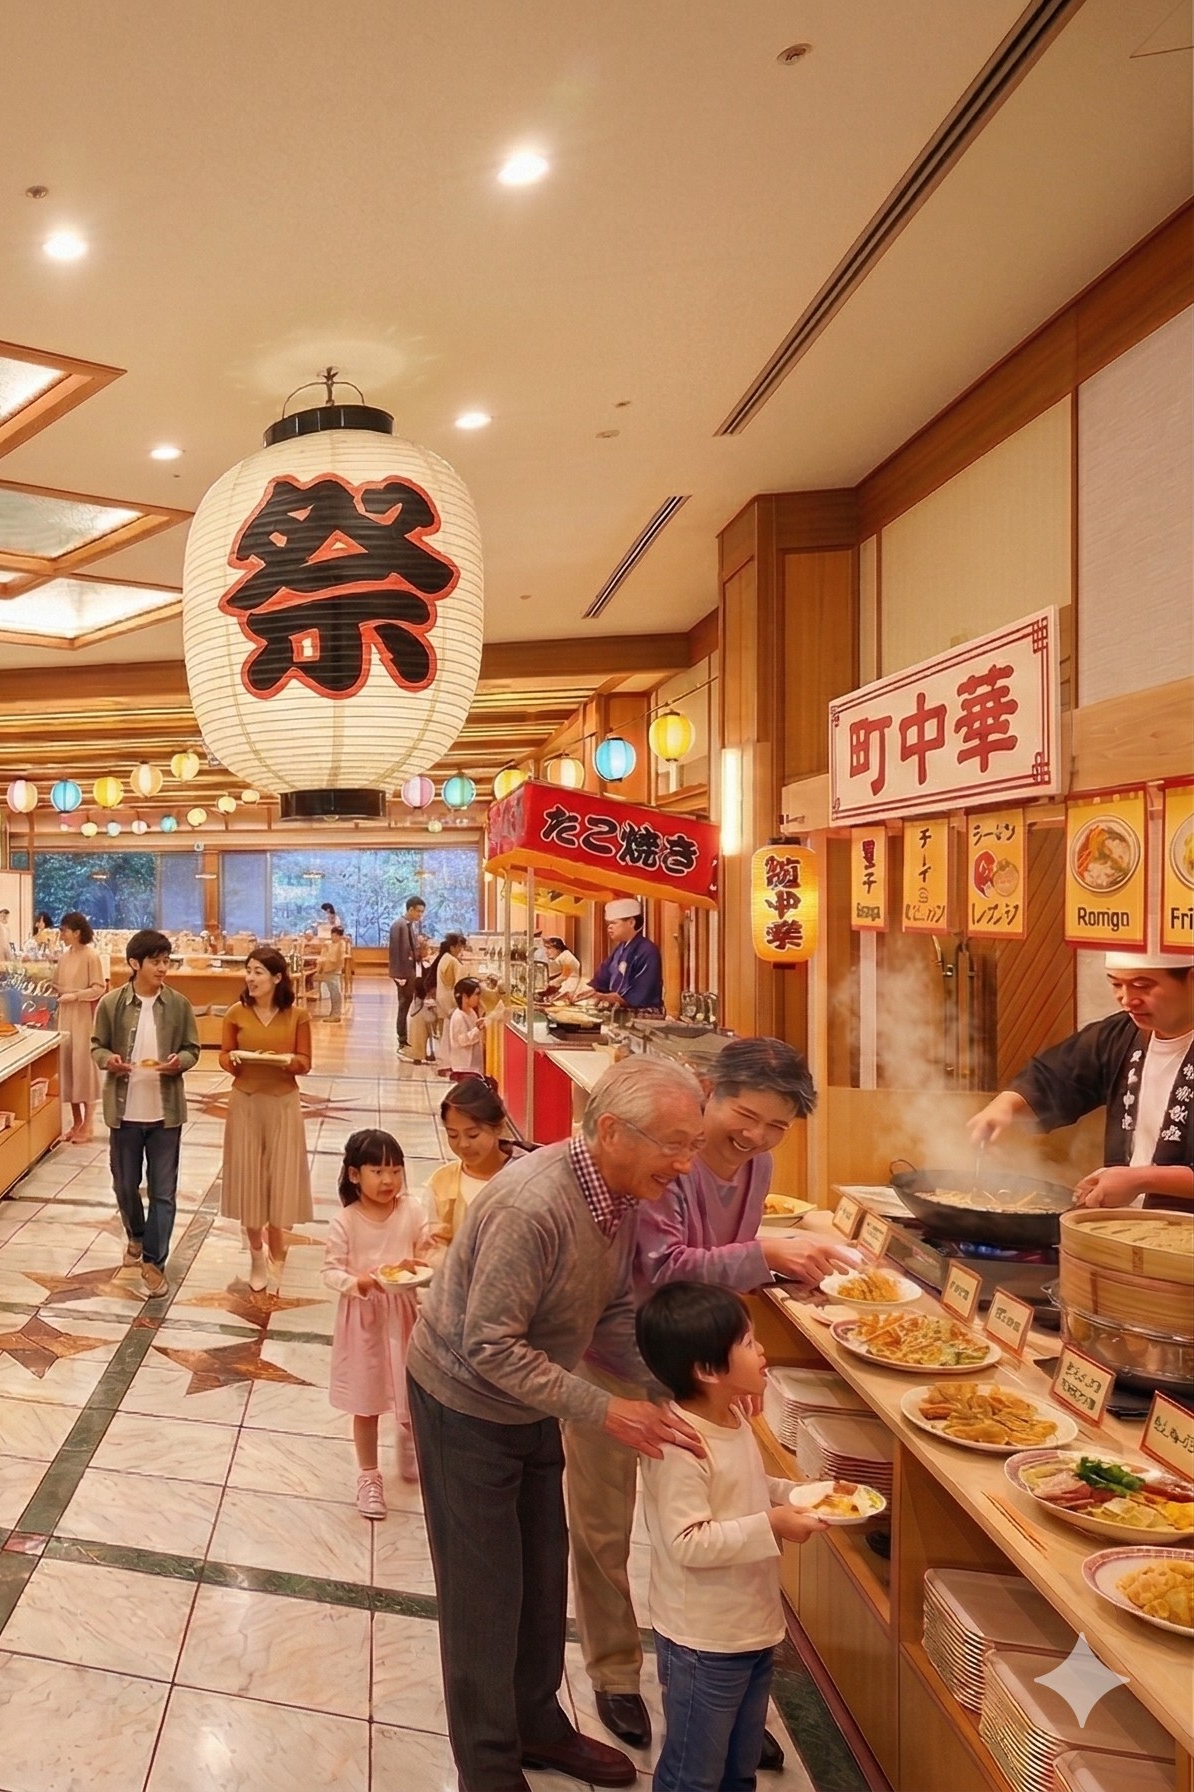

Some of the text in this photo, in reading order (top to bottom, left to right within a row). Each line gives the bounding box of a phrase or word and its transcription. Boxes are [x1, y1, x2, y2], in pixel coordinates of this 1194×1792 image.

[218, 472, 461, 700] 祭
[848, 664, 1019, 796] 町中華
[540, 803, 700, 877] たこ焼き
